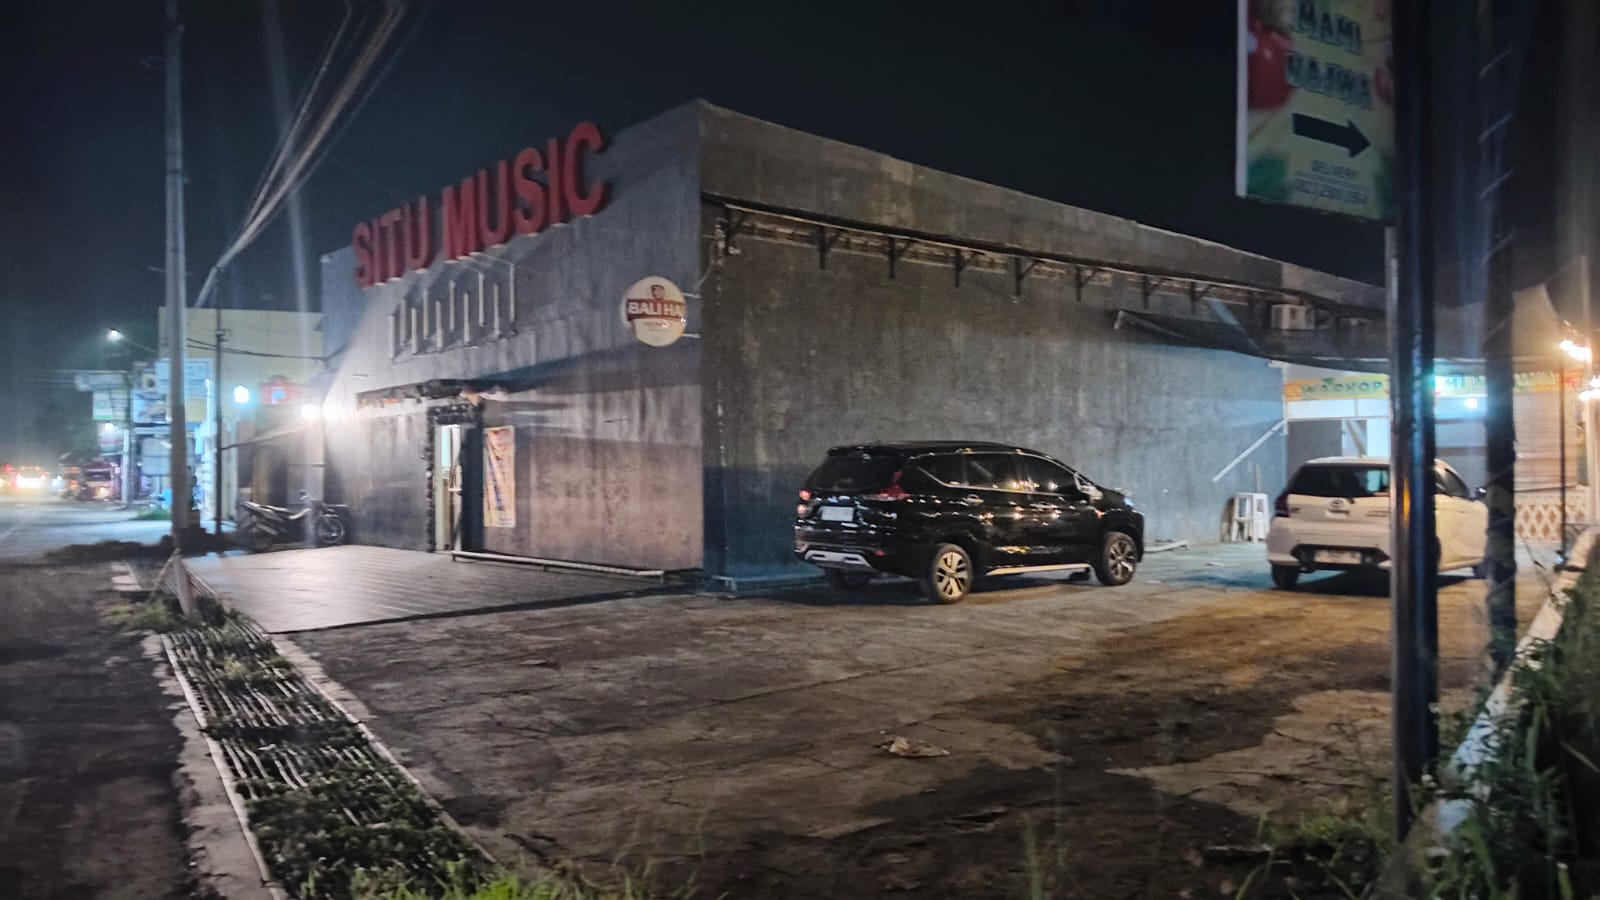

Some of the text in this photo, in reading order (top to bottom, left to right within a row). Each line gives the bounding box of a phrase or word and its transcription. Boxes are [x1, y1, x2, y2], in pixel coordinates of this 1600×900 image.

[354, 121, 608, 288] SITU MUSIC
[628, 300, 662, 315] BALI
[1301, 380, 1383, 394] WARKOP
